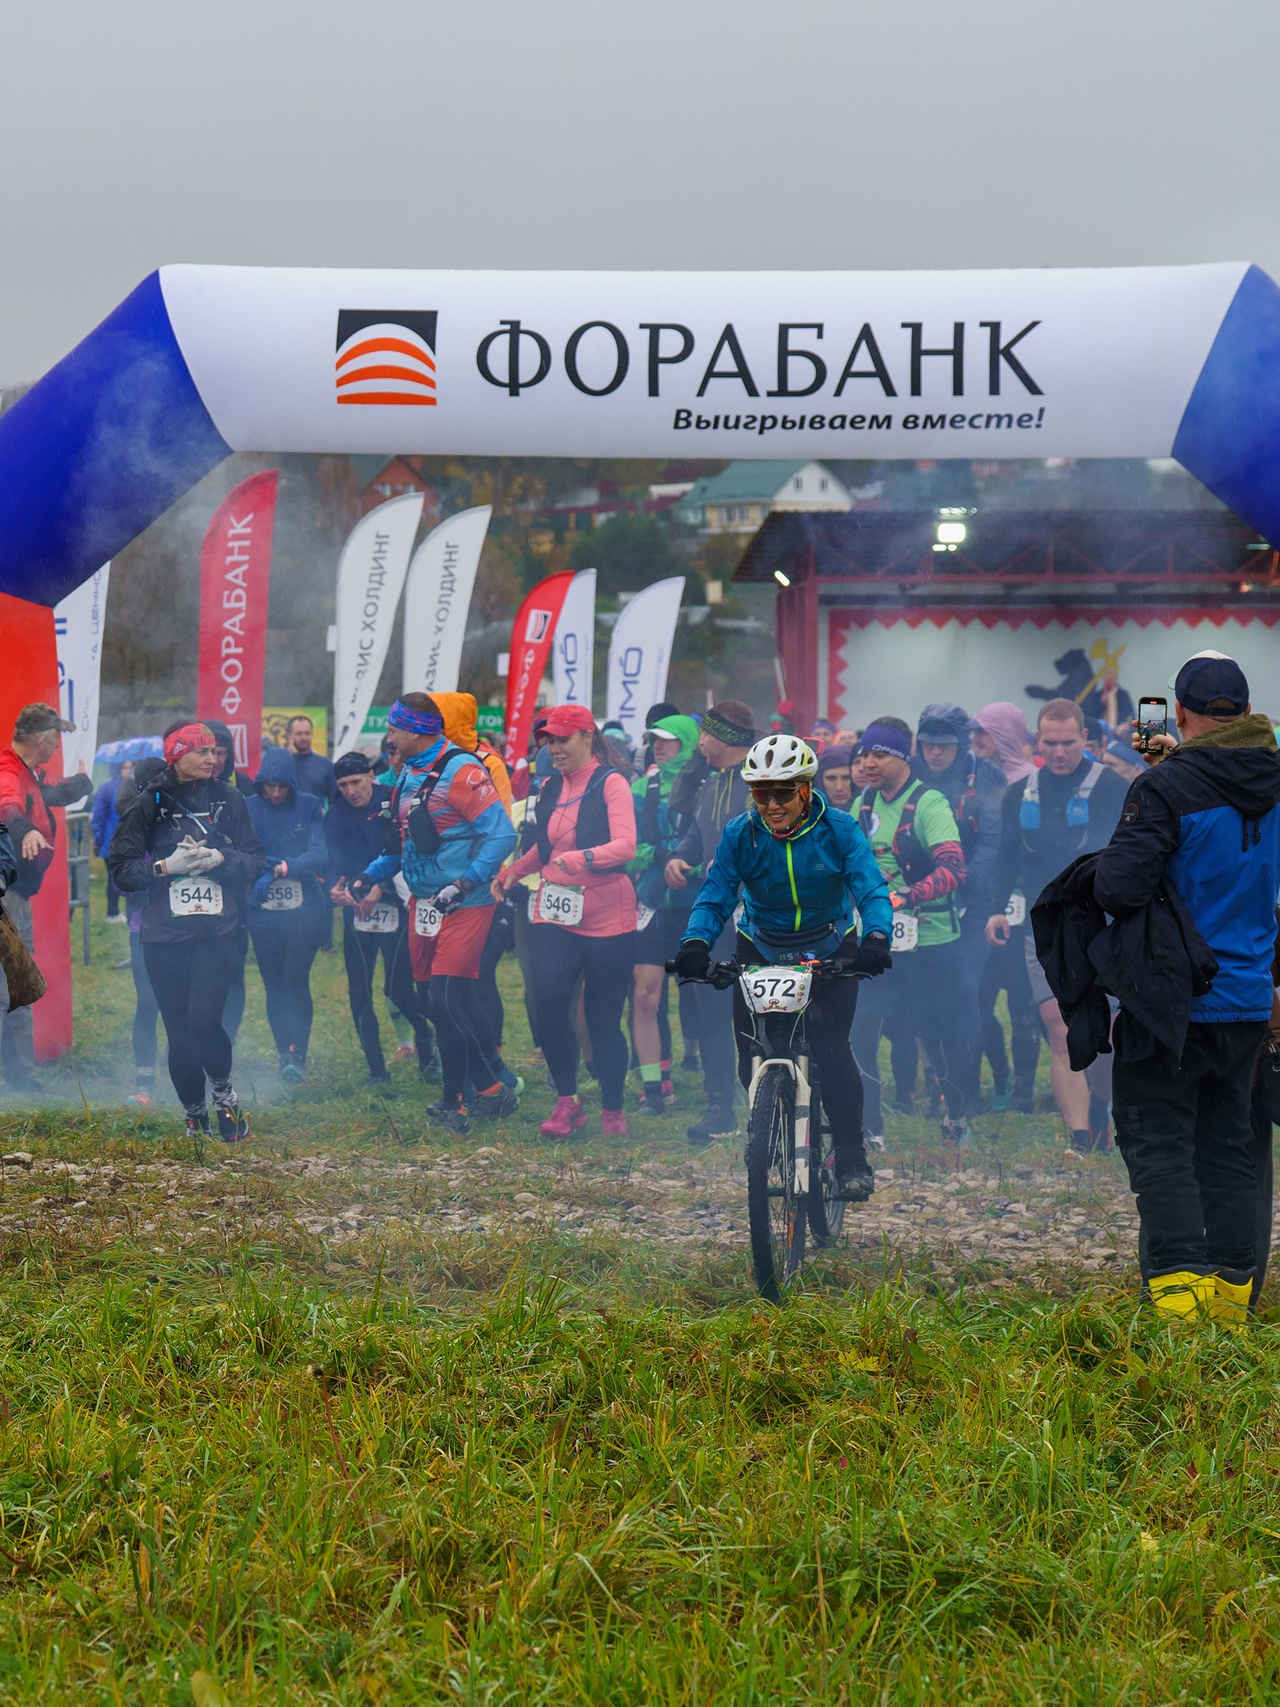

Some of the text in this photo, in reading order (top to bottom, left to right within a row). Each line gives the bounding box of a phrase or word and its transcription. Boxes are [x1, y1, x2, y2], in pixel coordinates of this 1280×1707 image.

[476, 317, 1045, 398] ФОРАБАНК
[672, 406, 1045, 436] Выигрываем вместе!
[361, 530, 391, 634] ХОЛДИНГ
[221, 512, 254, 715] ФОРАБАНК
[180, 886, 213, 904] 544
[545, 893, 571, 914] 546
[753, 979, 796, 998] 572
